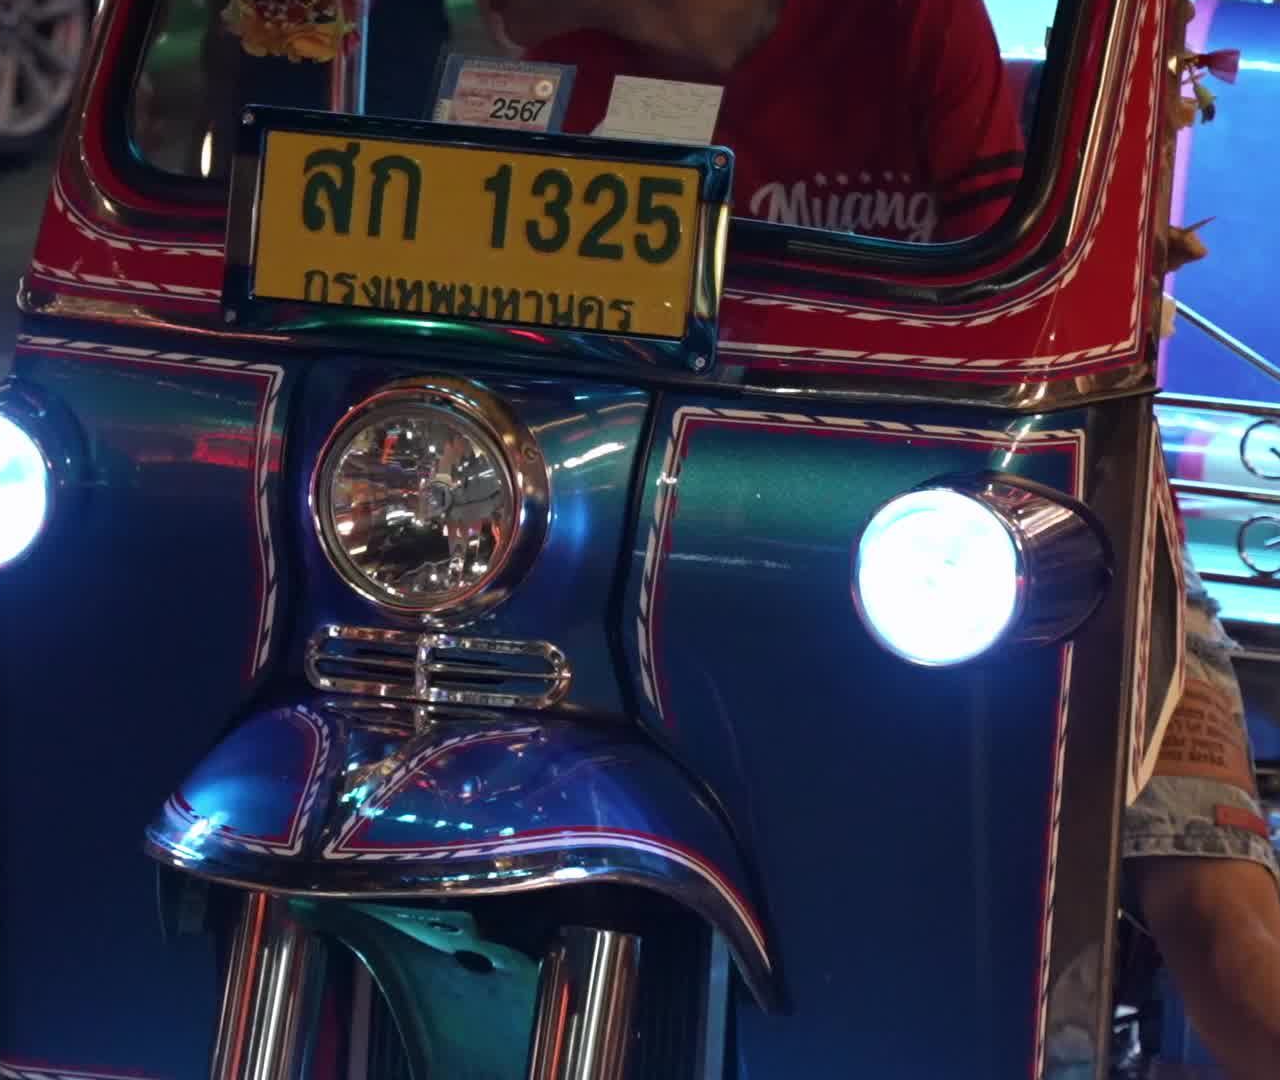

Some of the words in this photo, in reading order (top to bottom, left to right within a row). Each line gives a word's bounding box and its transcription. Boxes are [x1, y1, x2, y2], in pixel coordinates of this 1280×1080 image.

[489, 98, 546, 122] 2567
[301, 142, 423, 241] สก
[483, 163, 685, 265] 1325
[749, 178, 938, 243] Muang
[302, 269, 635, 331] กรงเทพมหานคร
